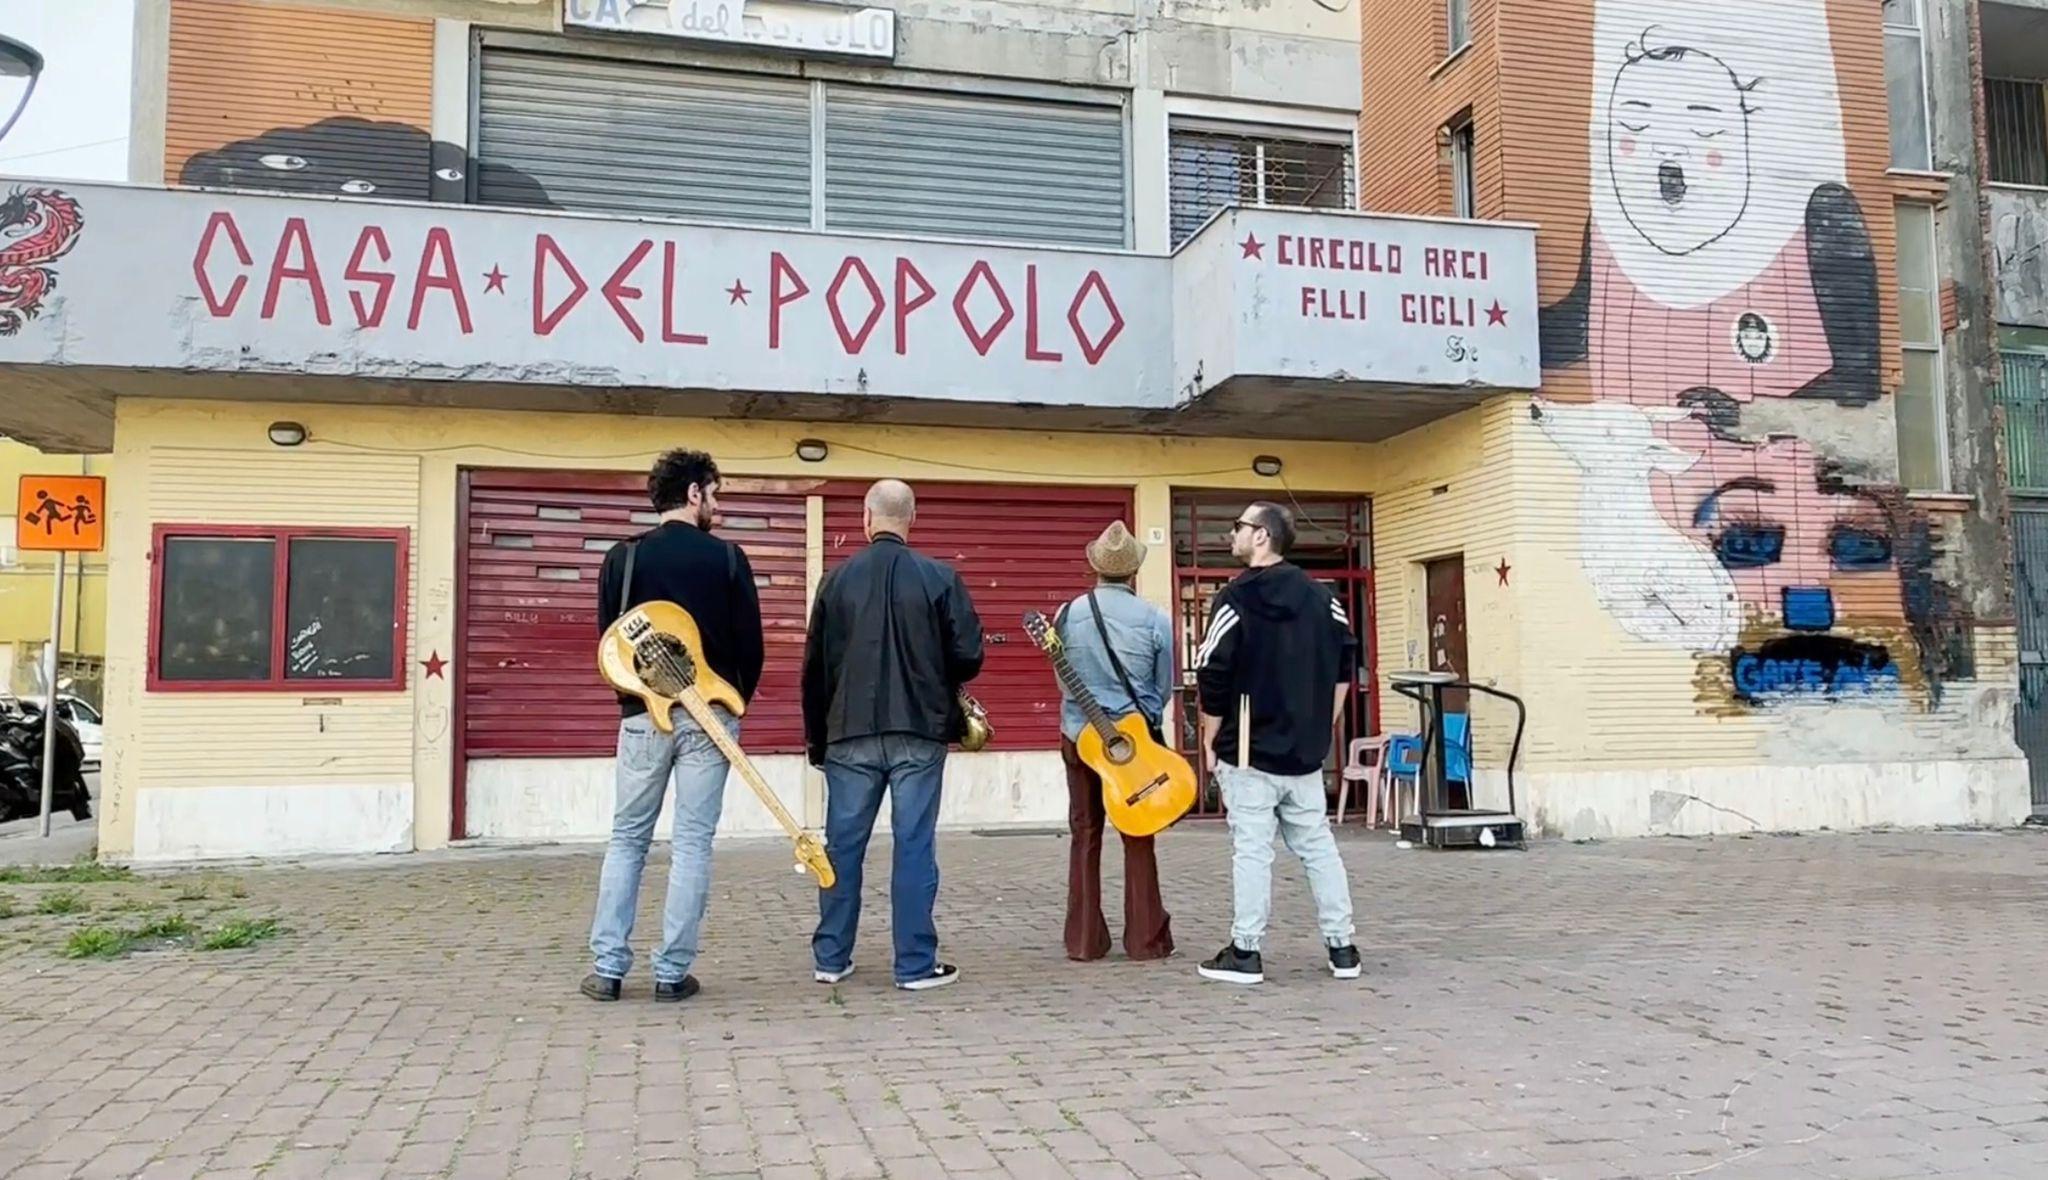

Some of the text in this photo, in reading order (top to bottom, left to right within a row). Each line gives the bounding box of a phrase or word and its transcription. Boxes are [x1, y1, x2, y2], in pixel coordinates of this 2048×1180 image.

[682, 2, 729, 36] del
[1278, 234, 1488, 280] CIRCOLO ARCI
[193, 211, 1125, 366] CASA DEL POPOLO
[1302, 287, 1475, 327] F.LLI GIGLI
